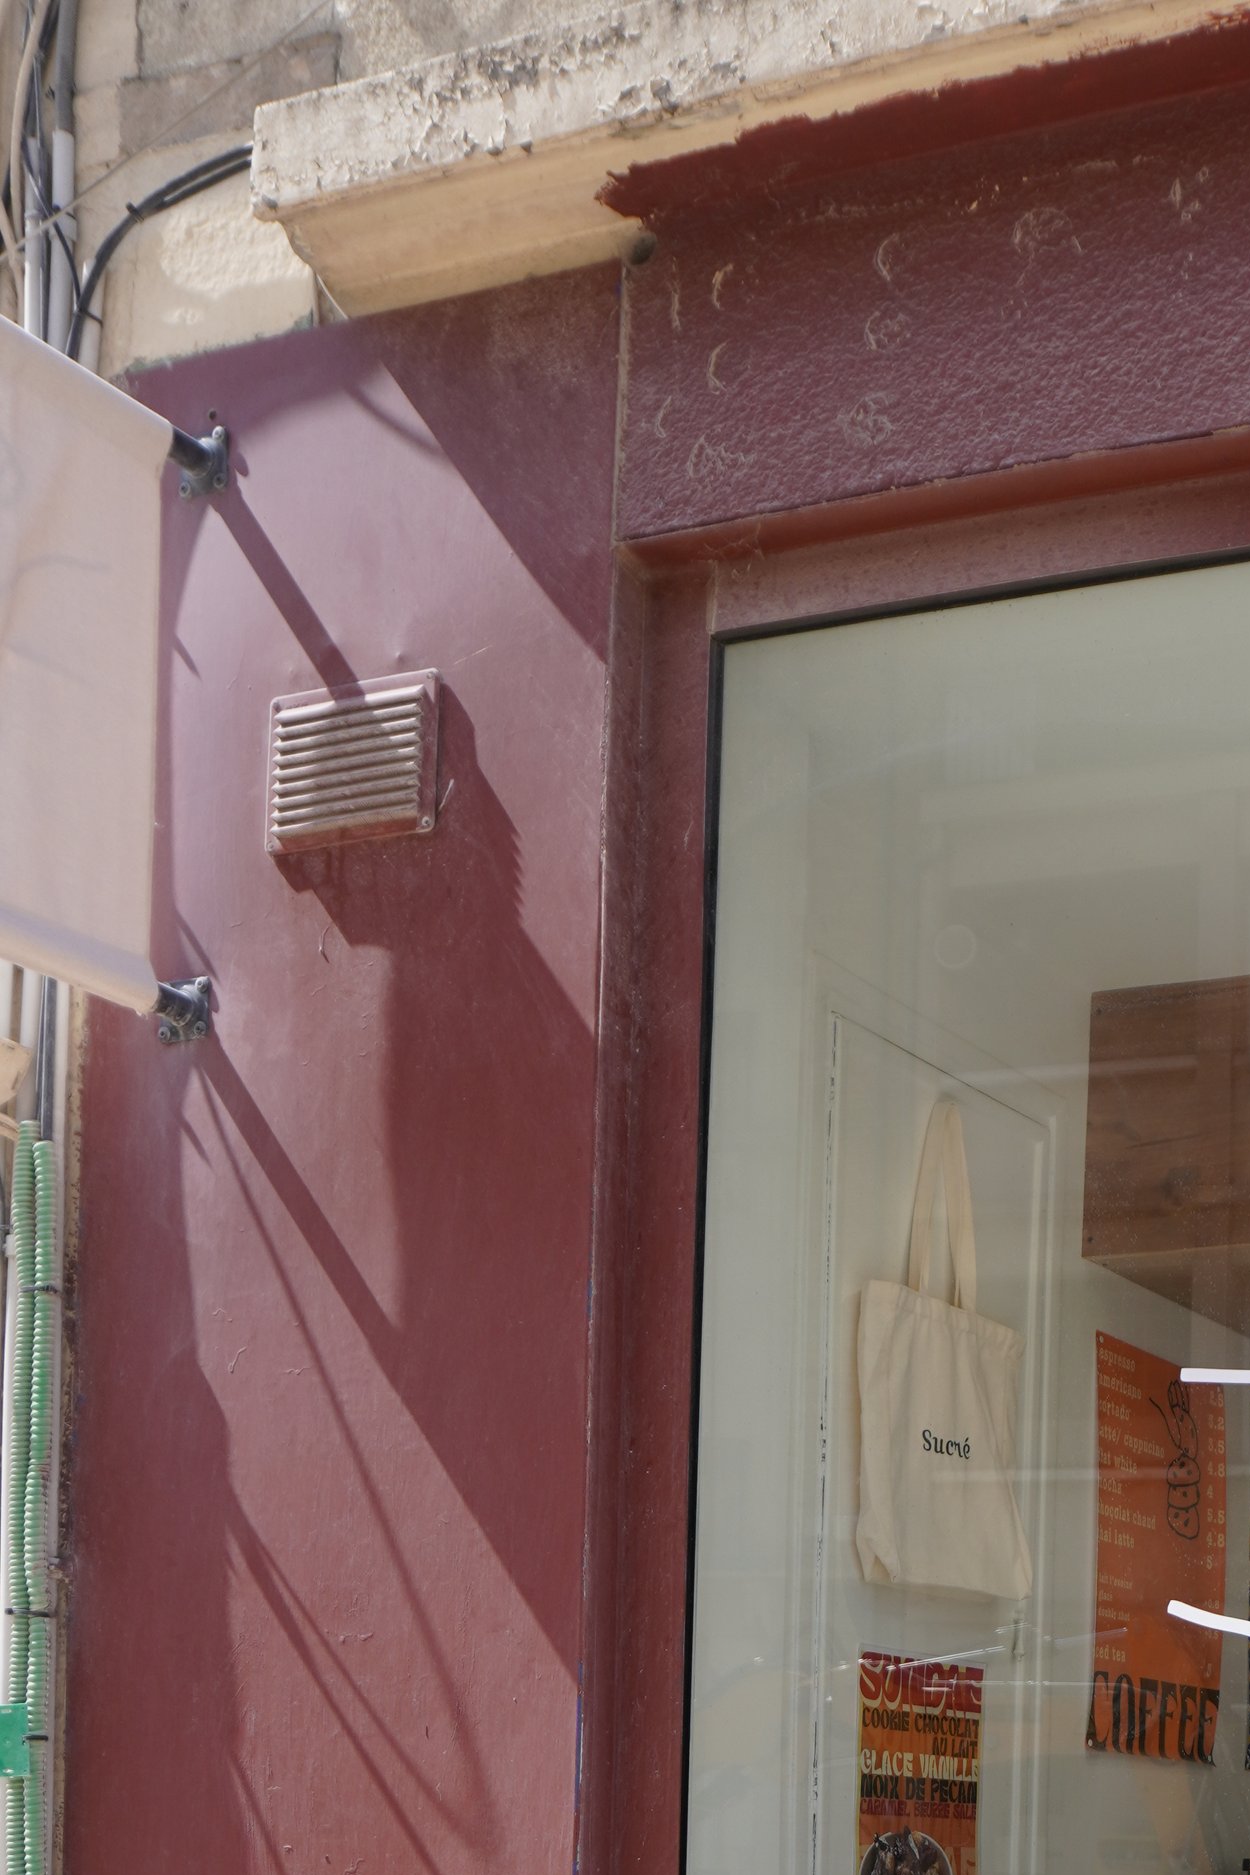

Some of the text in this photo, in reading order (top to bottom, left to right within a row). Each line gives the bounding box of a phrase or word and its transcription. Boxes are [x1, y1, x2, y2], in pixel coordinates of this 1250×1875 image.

[1100, 1347, 1136, 1373] espresso
[922, 1429, 971, 1460] Sucré
[1124, 1434, 1165, 1458] cappucino
[1114, 1455, 1138, 1474] white
[1132, 1513, 1157, 1530] chaud
[1115, 1529, 1135, 1549] latte
[1094, 1645, 1126, 1662] ced tea
[859, 1651, 984, 1719] SUNDAE
[862, 1707, 980, 1738] COOKIE CHOCOLAT
[1086, 1671, 1220, 1768] COFFEE
[932, 1737, 978, 1759] AU LAIT
[861, 1748, 978, 1782] GLACE VANILLE
[861, 1773, 978, 1804] NOIX DE PECAN
[860, 1799, 911, 1817] CARAMEL
[914, 1801, 950, 1818] BEURRE
